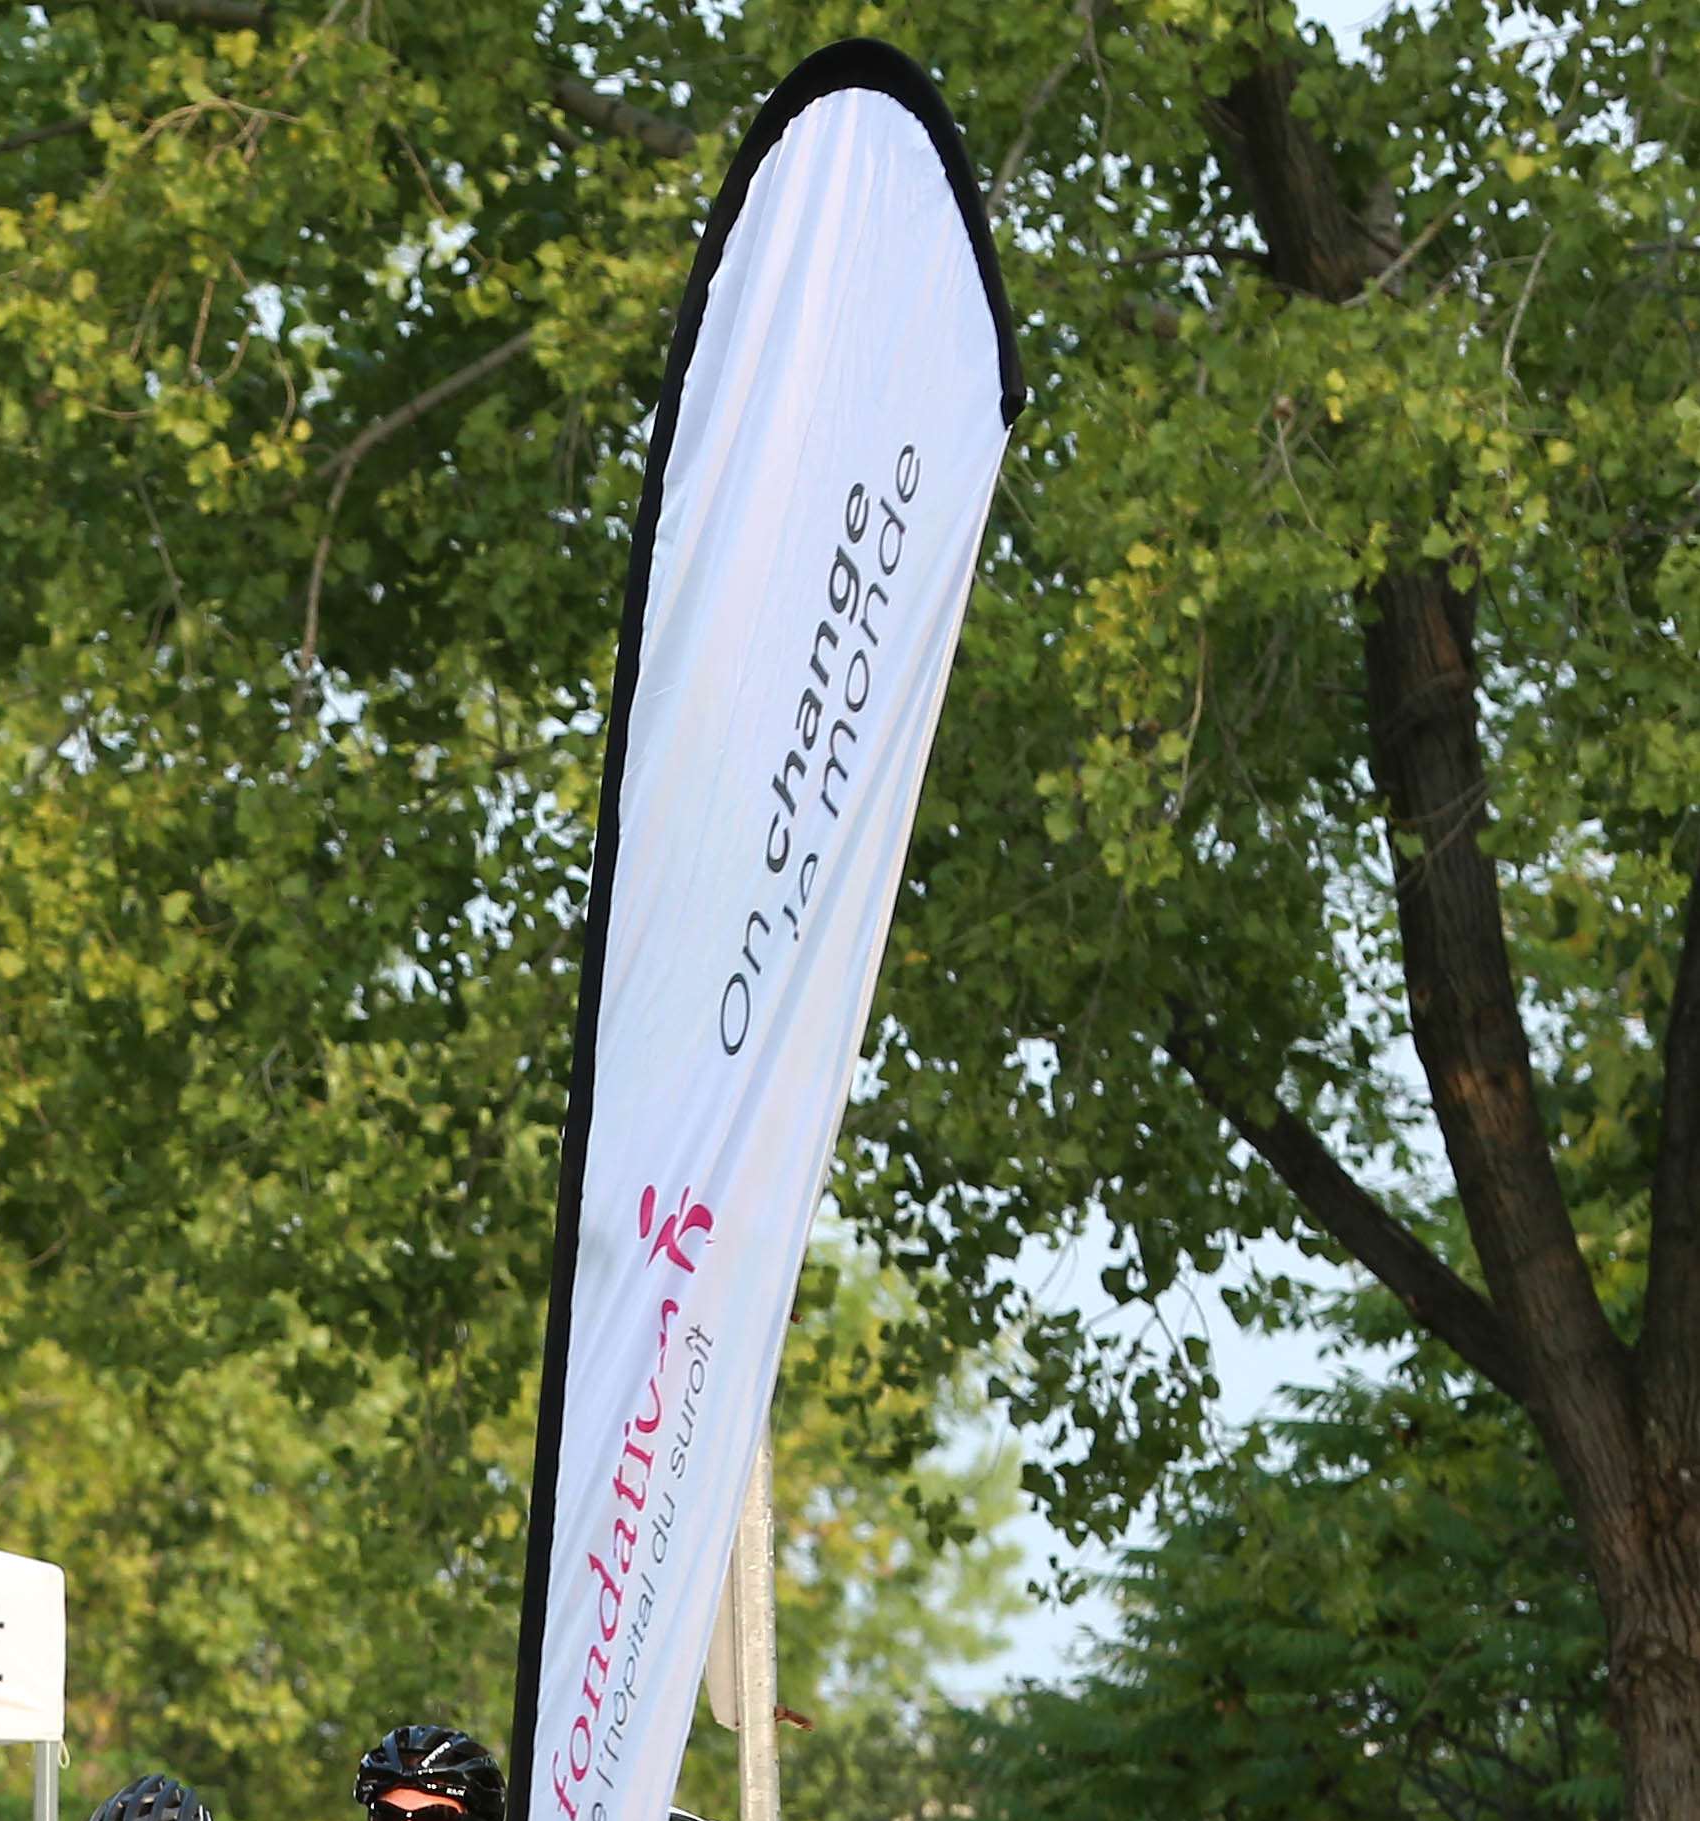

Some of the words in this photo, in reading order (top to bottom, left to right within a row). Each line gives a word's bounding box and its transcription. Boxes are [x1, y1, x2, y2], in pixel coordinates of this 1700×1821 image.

[720, 910, 771, 1055] On
[767, 481, 869, 874] change
[820, 442, 922, 819] monde
[650, 1491, 678, 1565] du
[671, 1323, 714, 1476] suroît
